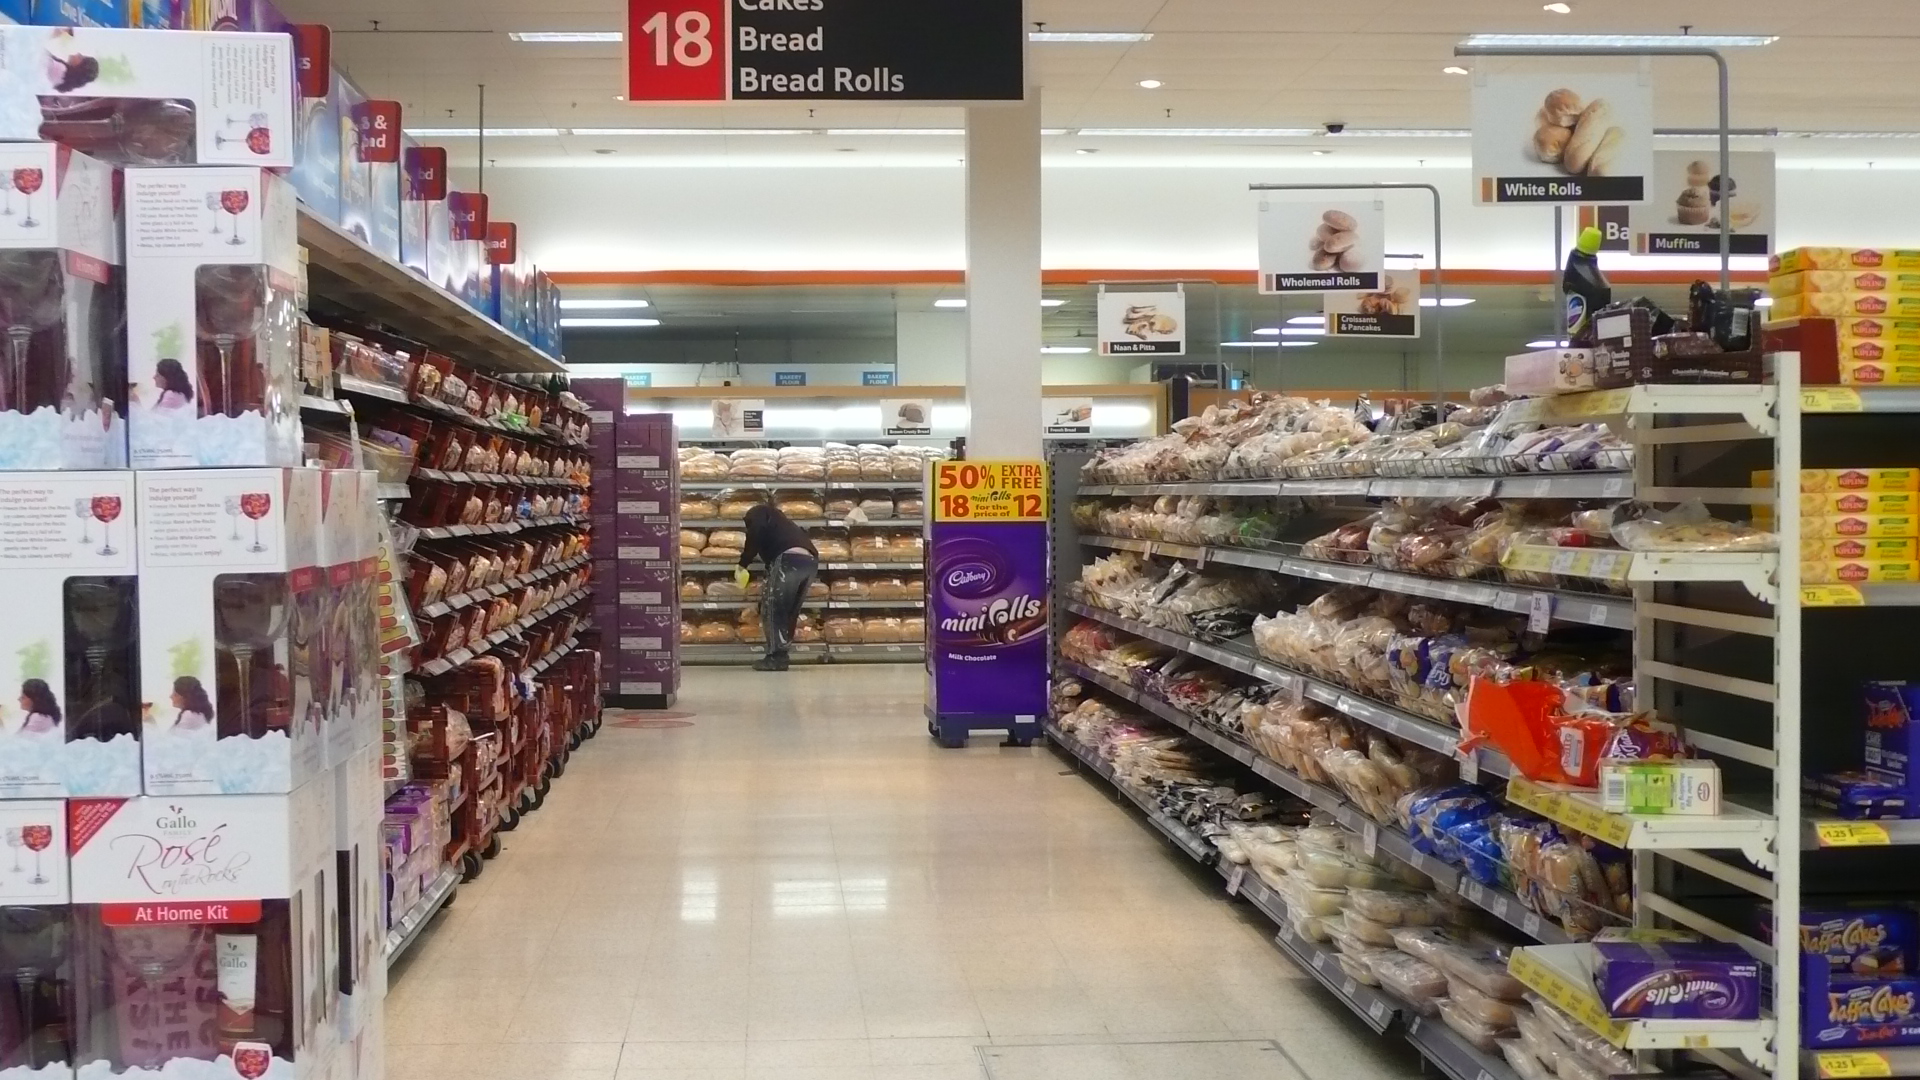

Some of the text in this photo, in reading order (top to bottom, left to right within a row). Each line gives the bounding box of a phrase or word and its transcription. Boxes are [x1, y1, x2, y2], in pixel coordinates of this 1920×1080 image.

[641, 11, 713, 67] 18
[739, 26, 824, 52] Bread
[739, 66, 905, 93] Bread Rolls
[1505, 182, 1583, 196] White Rolls
[1655, 237, 1700, 250] Muffins
[1281, 275, 1360, 288] Wholemeal Rolls
[1856, 302, 1885, 310] KIPLING
[1340, 316, 1378, 324] Croissants
[1348, 324, 1382, 332] Pancakes
[1854, 349, 1882, 357] KIPLING
[1854, 371, 1882, 379] KIPLING
[939, 464, 1042, 490] 50% EXTRA
[1002, 477, 1042, 489] FREE
[940, 494, 970, 518] 18
[1013, 494, 1042, 517] 12
[949, 570, 988, 586] Cadbury
[948, 652, 963, 661] Milk
[156, 816, 196, 829] Gallo
[110, 824, 227, 894] Rosé
[135, 904, 228, 921] At Home Kit
[220, 957, 248, 968] Gallo
[1828, 986, 1915, 1022] Jaffa Cakes
